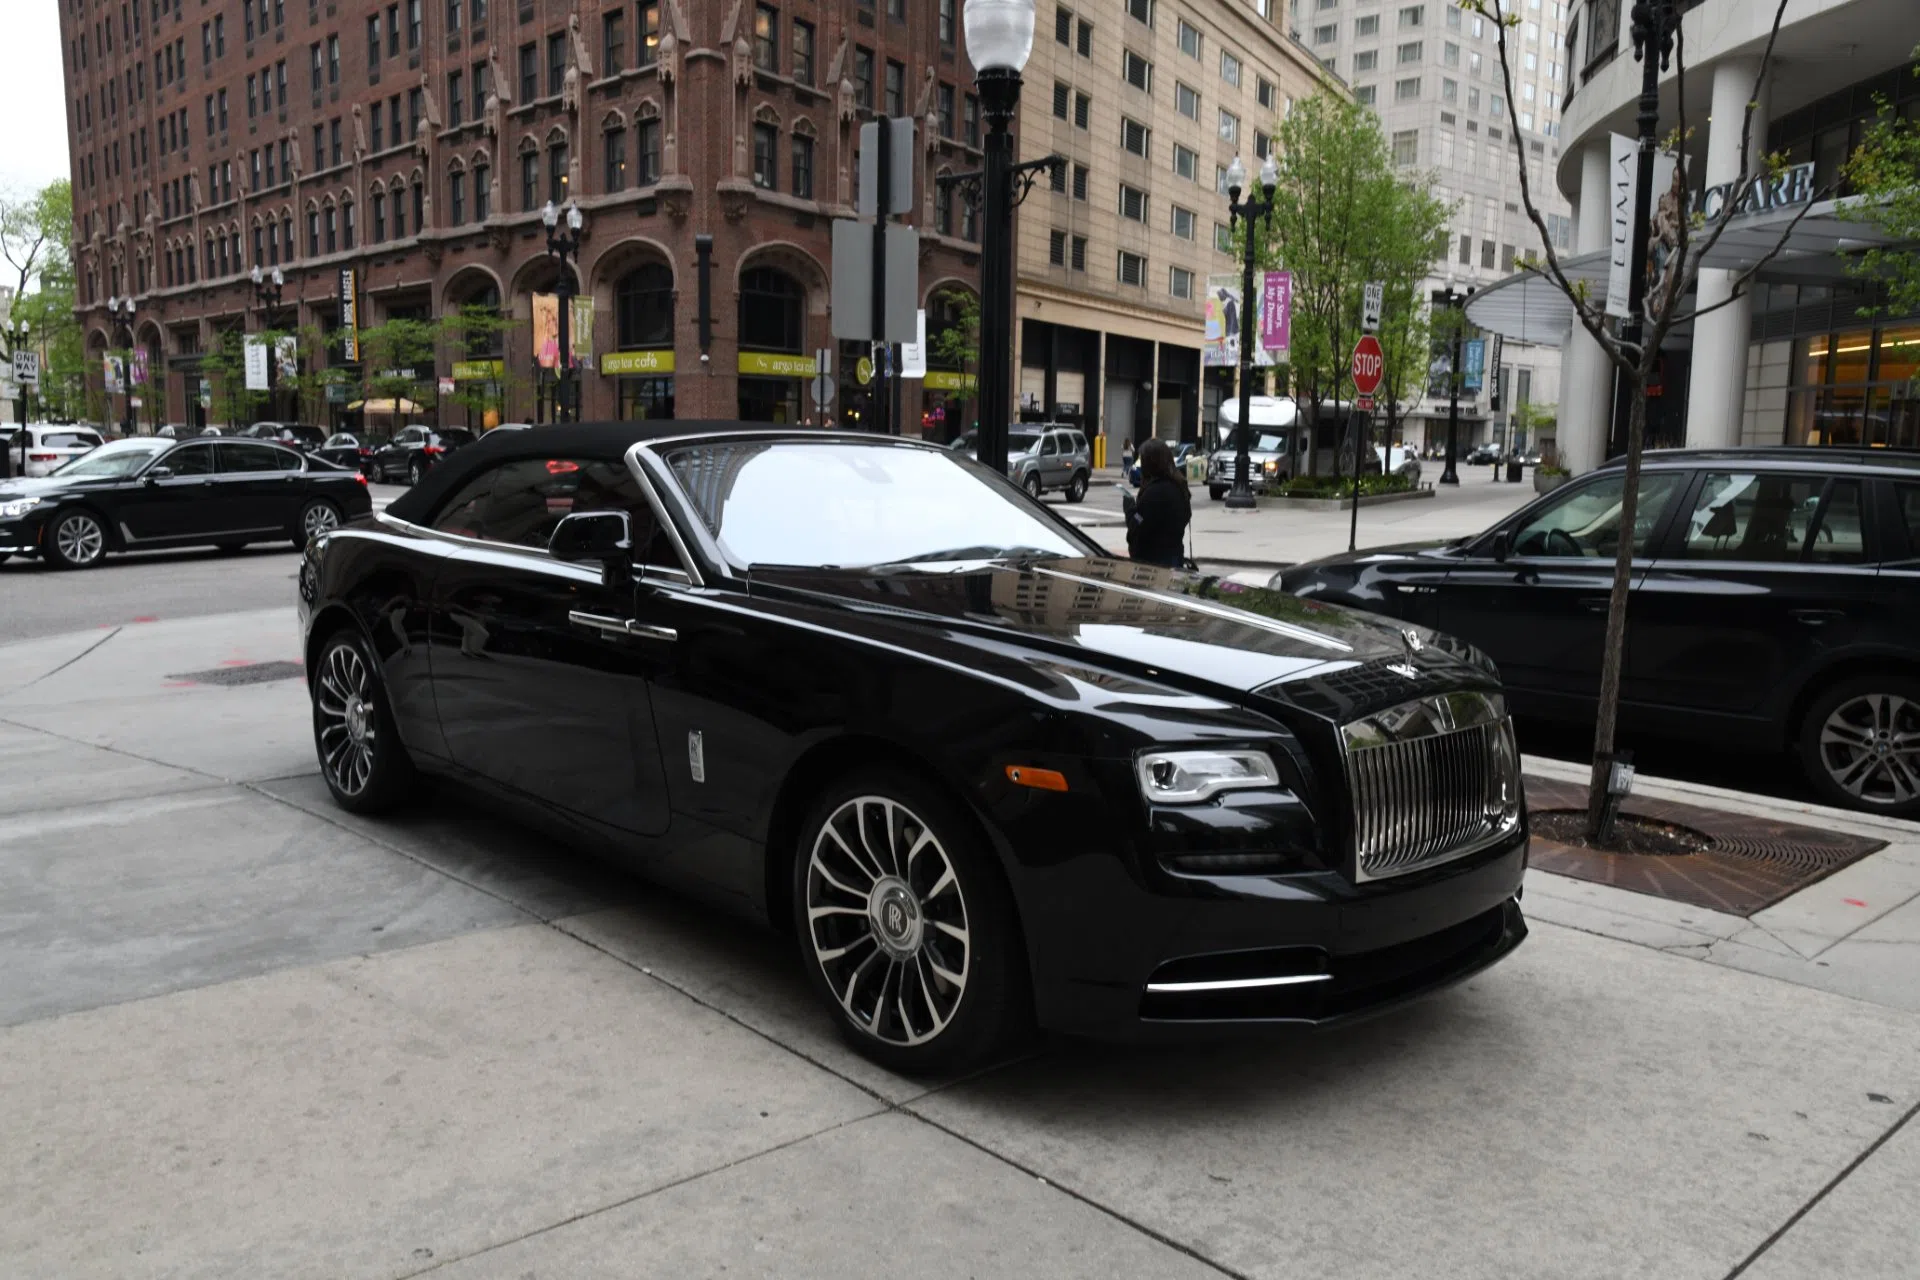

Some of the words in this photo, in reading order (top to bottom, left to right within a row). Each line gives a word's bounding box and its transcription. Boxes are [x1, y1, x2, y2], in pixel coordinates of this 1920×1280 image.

[1265, 286, 1275, 300] My
[1366, 286, 1380, 300] ONE
[1365, 301, 1380, 313] WAY
[344, 325, 355, 360] EINSTN
[15, 352, 36, 362] ONE
[15, 362, 37, 371] WAY
[1354, 352, 1381, 377] STOP
